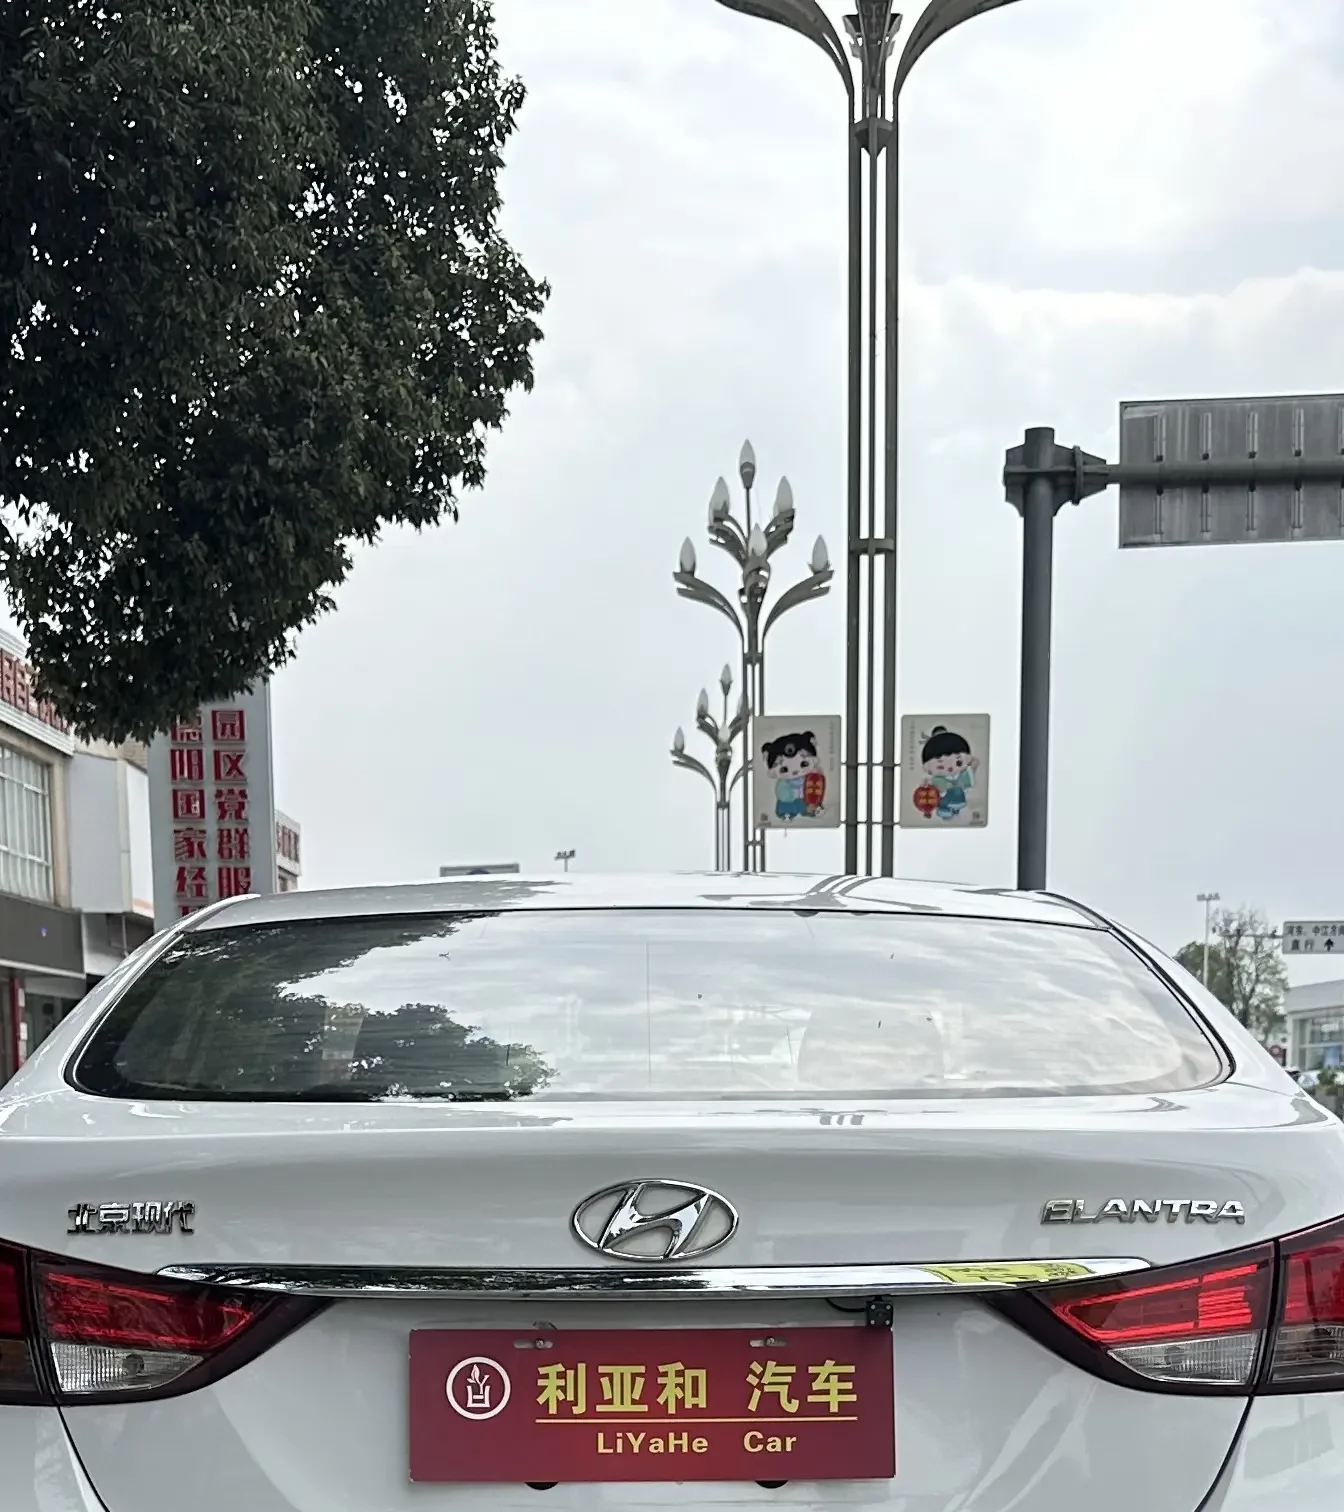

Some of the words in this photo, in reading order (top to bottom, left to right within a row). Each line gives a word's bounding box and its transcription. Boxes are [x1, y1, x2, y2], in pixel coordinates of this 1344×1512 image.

[67, 1200, 196, 1235] 北京现代
[1040, 1198, 1246, 1225] ELANTRA
[536, 1361, 708, 1415] 利亚和
[746, 1359, 858, 1414] 汽车
[597, 1431, 709, 1455] LiYaHe
[743, 1430, 797, 1454] Car
